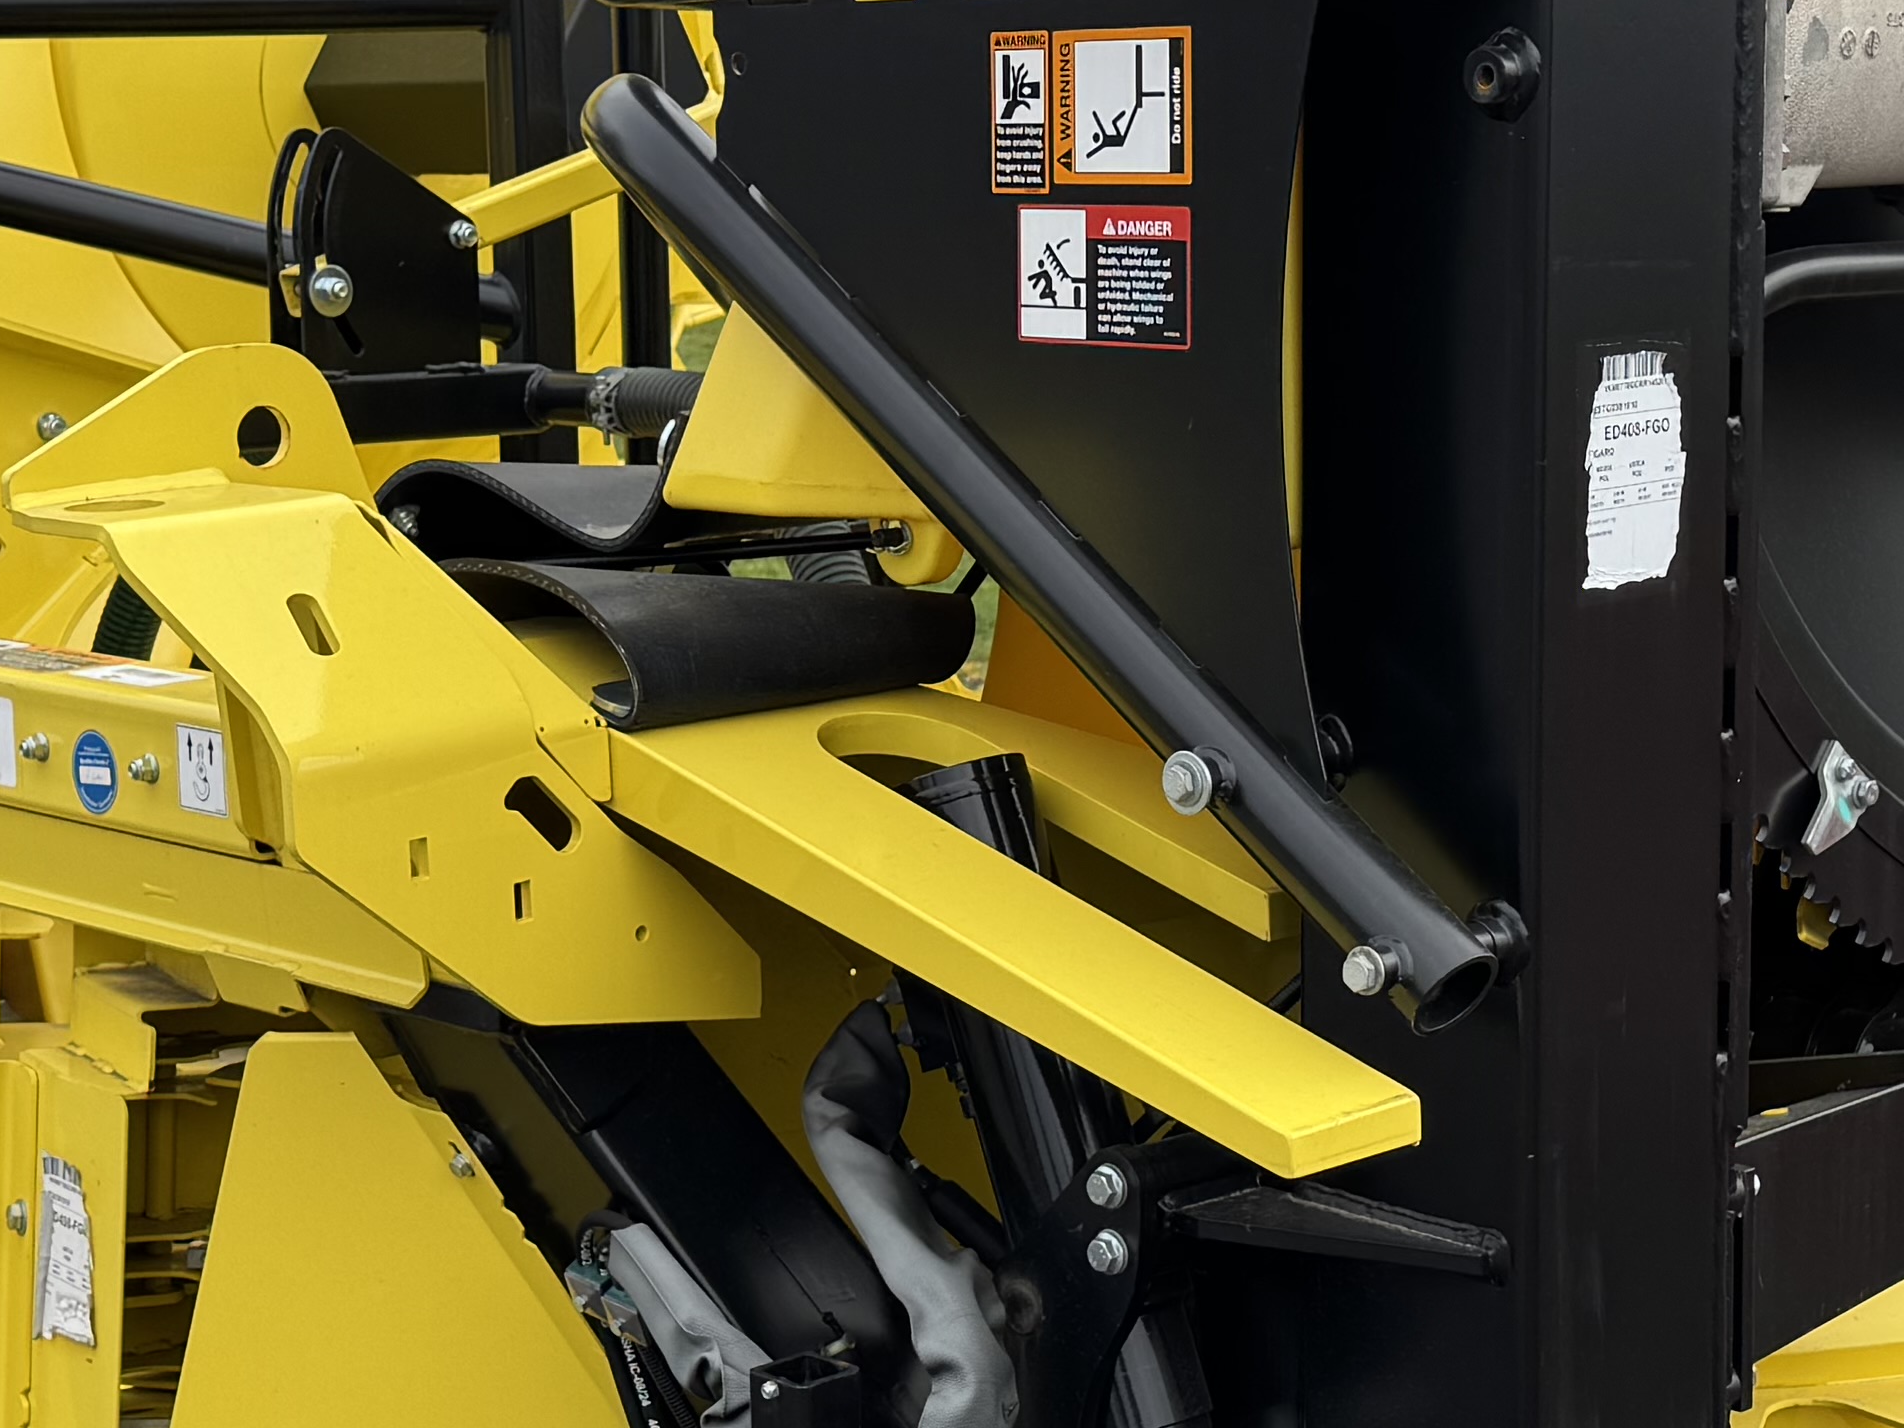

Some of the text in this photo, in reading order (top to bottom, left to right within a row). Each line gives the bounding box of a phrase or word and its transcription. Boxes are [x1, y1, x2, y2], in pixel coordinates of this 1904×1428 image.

[1002, 35, 1045, 47] WARNING
[1060, 43, 1072, 141] WARNING
[1172, 66, 1181, 144] Do not ride
[1117, 220, 1172, 236] DANGER
[621, 1336, 637, 1367] SHA
